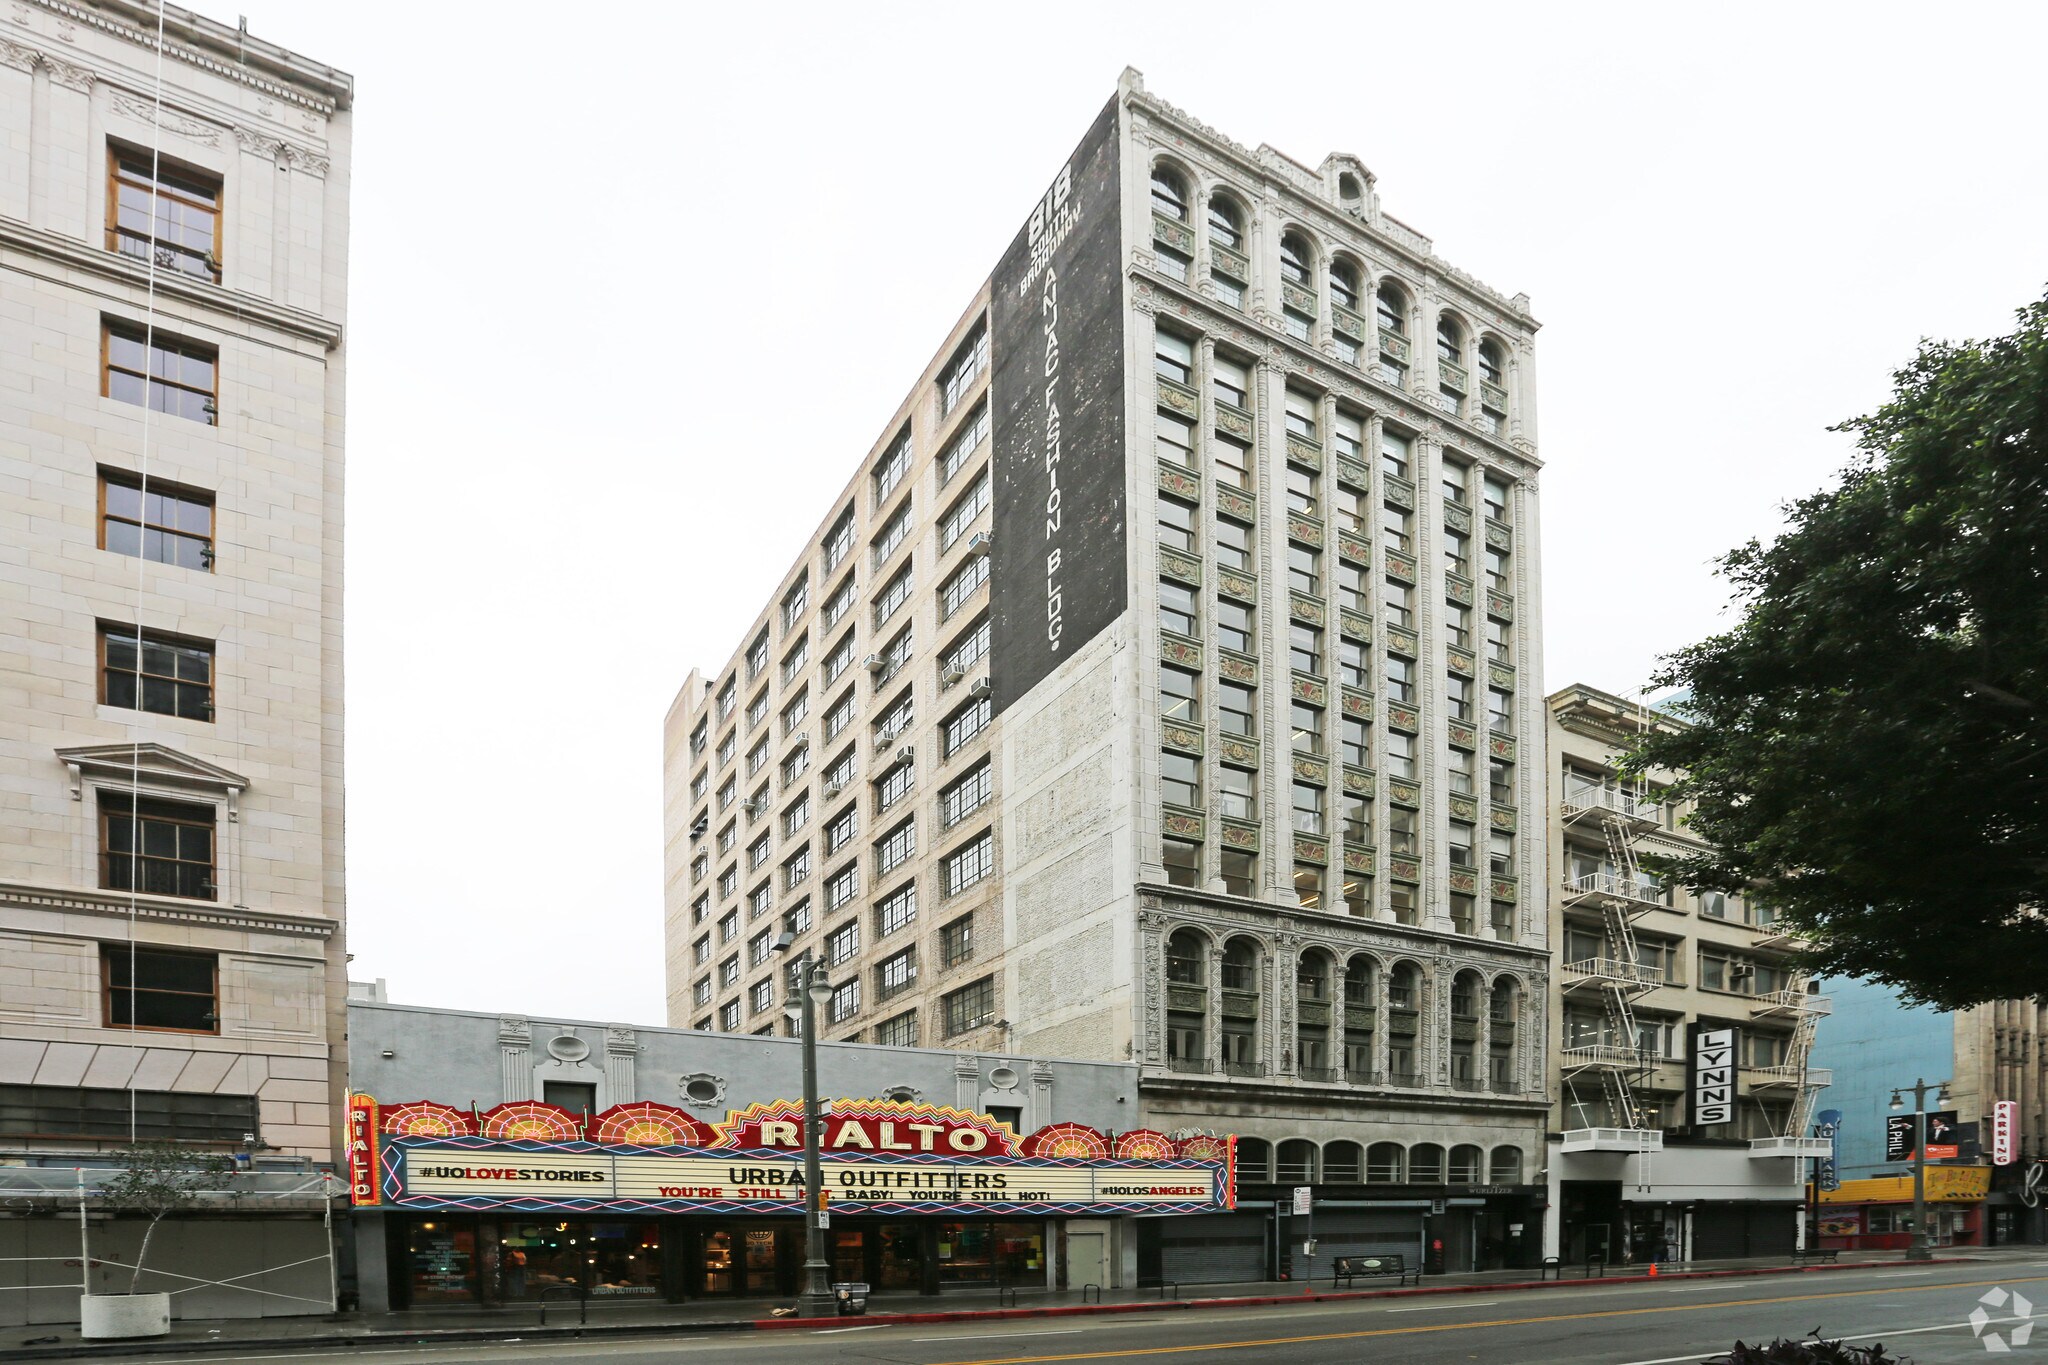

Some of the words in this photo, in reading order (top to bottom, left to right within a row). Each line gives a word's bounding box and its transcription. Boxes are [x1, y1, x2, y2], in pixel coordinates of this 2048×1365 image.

[1028, 163, 1071, 247] 818
[1030, 201, 1069, 266] SOUTH
[1020, 201, 1081, 297] BROADWAY
[1043, 267, 1060, 377] ANJAC
[1045, 376, 1061, 540] FASHION
[1047, 548, 1062, 651] BLDG.
[1330, 927, 1401, 947] WURLITZER
[1702, 1034, 1726, 1121] LYNNS
[351, 1110, 371, 1195] RIALTO
[1889, 1118, 1902, 1129] LA
[1996, 1104, 2007, 1162] PARKING
[420, 1166, 605, 1182] #UOLOVESTORIES
[658, 1187, 723, 1199] YOU'RE
[738, 1188, 786, 1199] STILL
[800, 1189, 836, 1200] HT,
[845, 1189, 893, 1200] BABY!
[909, 1190, 962, 1201] YOU'RE
[971, 1191, 1011, 1201] STILL
[1018, 1191, 1051, 1201] HOT!
[839, 1171, 1007, 1188] OUTFITTERS
[1102, 1186, 1205, 1195] #UOLOSANGELES
[1823, 1157, 1835, 1186] PARK
[616, 1286, 656, 1294] OUTFITTERS
